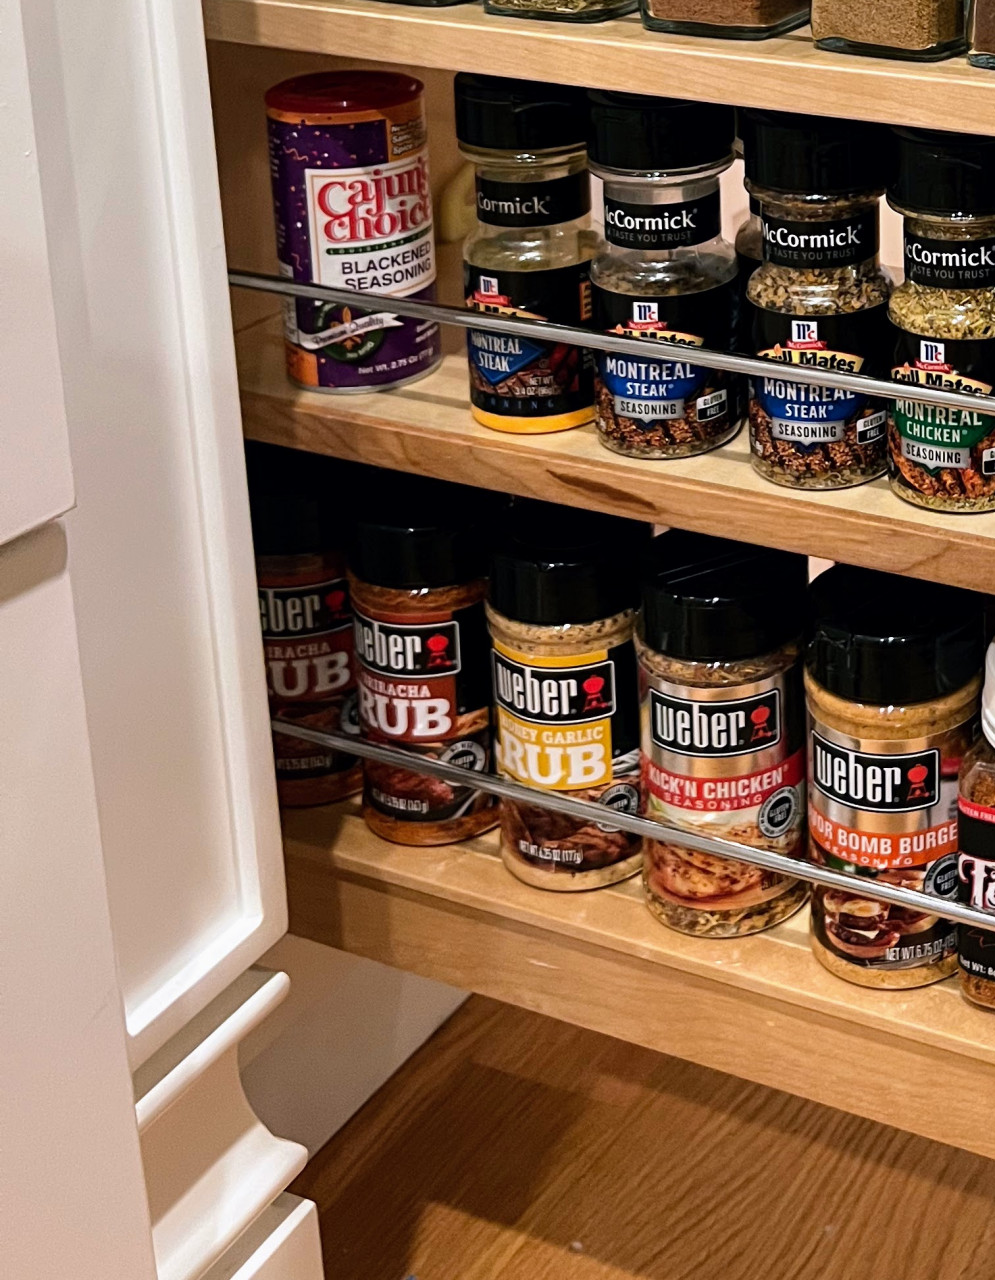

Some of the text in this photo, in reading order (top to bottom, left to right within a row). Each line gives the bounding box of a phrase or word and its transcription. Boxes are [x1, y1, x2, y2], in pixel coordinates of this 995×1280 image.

[637, 230, 691, 243] YOU TRUST
[341, 241, 431, 275] BLACKENED
[801, 247, 855, 260] YOU TRUST
[904, 238, 995, 267] cCormick
[345, 257, 431, 290] SEASONING
[934, 268, 990, 279] YOU TRUST
[470, 330, 522, 355] MONTREAL
[478, 351, 510, 372] STEAK
[606, 356, 695, 381] MONTREAL
[800, 351, 856, 372] Mates
[626, 382, 667, 397] STEAK
[764, 377, 855, 402] MONTREAL
[620, 400, 677, 415] SEASONING
[785, 403, 827, 419] STEAK
[896, 399, 983, 426] MONTREAL
[779, 423, 837, 438] SEASONING
[906, 421, 960, 443] CHICKEN
[906, 442, 961, 463] SEASONING
[268, 651, 350, 697] UB
[496, 662, 578, 716] weber
[360, 684, 452, 736] RUB
[542, 726, 604, 744] GARLIC
[656, 703, 746, 748] weber
[502, 729, 606, 785] RUB
[649, 764, 783, 799] KICK'N CHICKEN
[815, 745, 901, 803] weber
[664, 792, 762, 810] SEASONING
[825, 841, 913, 865] SEASONING
[837, 828, 892, 855] BOMB
[886, 947, 900, 960] NET
[901, 945, 915, 959] WT
[917, 942, 933, 957] 6.75
